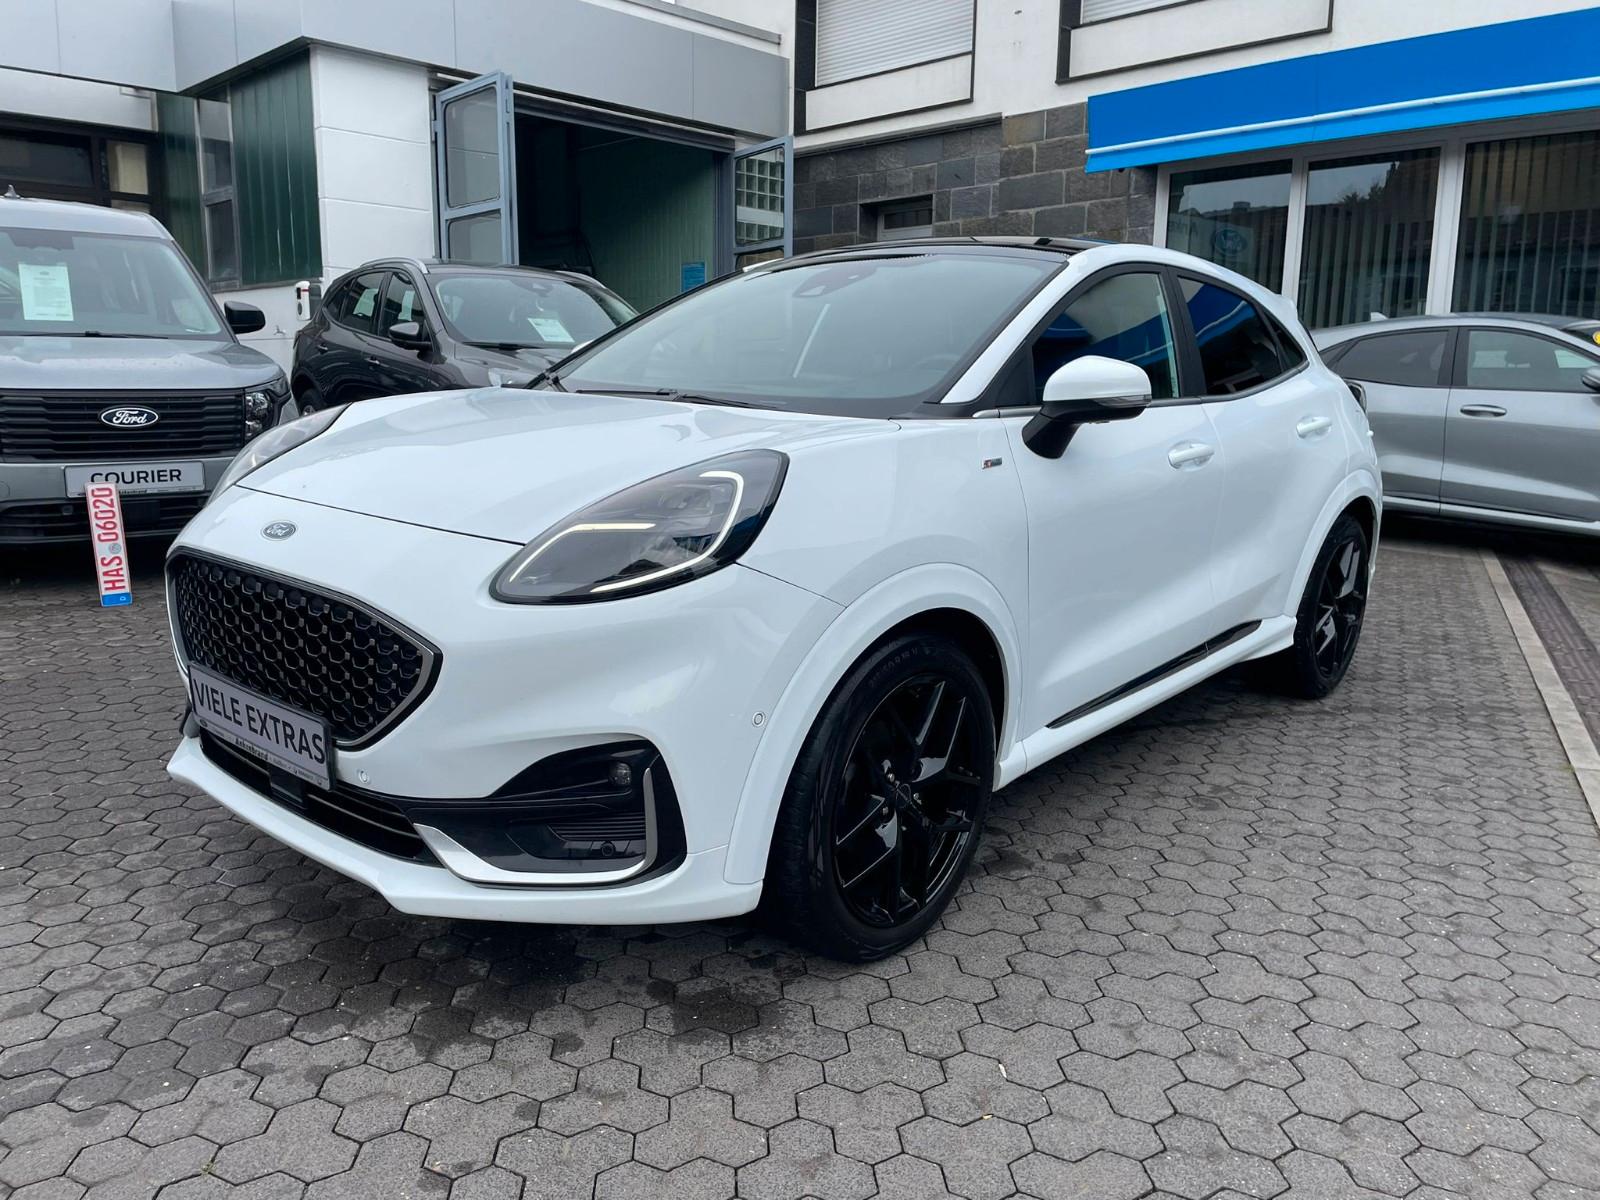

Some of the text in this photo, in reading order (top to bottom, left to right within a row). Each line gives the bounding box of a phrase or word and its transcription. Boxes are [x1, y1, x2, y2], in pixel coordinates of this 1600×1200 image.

[112, 410, 147, 424] Ford
[91, 469, 182, 484] COURIER
[91, 487, 126, 591] HAS 06020
[193, 679, 325, 764] VIELE EXTRAS
